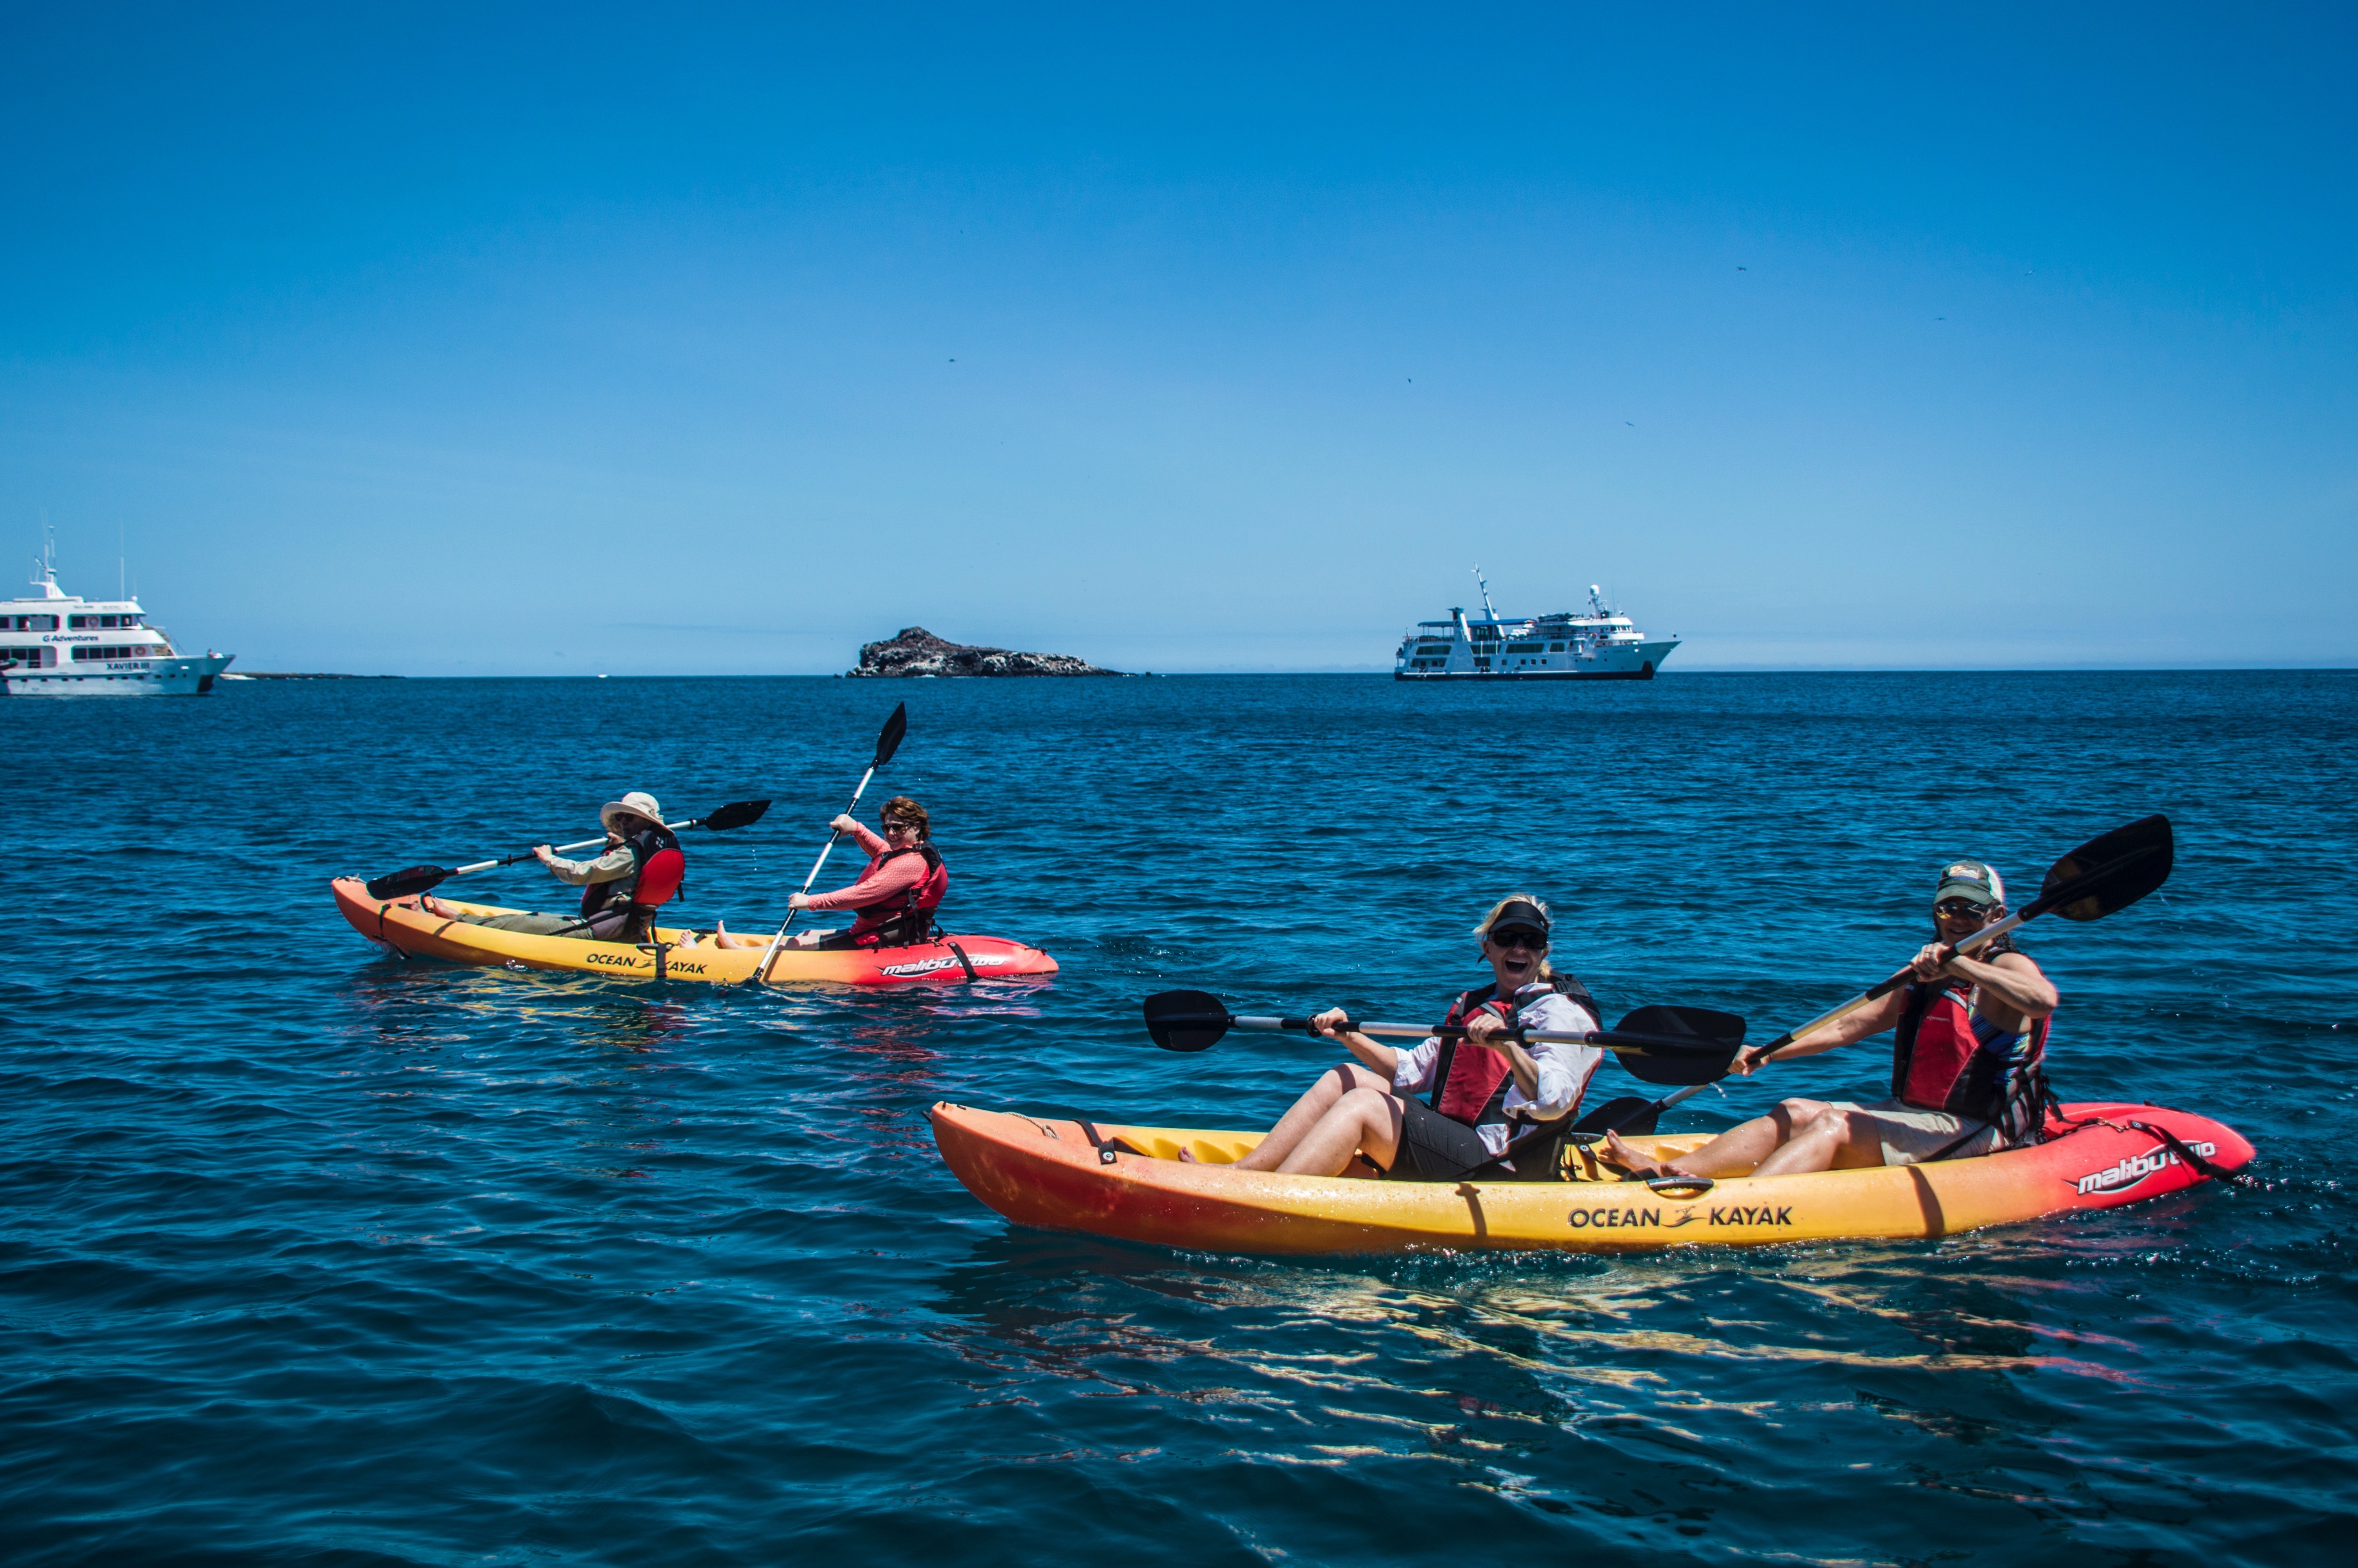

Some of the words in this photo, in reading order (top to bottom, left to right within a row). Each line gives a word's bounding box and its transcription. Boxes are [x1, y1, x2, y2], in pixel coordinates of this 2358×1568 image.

[587, 953, 636, 967] OCEAN
[881, 958, 956, 976] malibu
[2078, 1152, 2166, 1195] malibu
[1568, 1208, 1660, 1227] OCEAN
[1709, 1207, 1793, 1226] KAYAK
